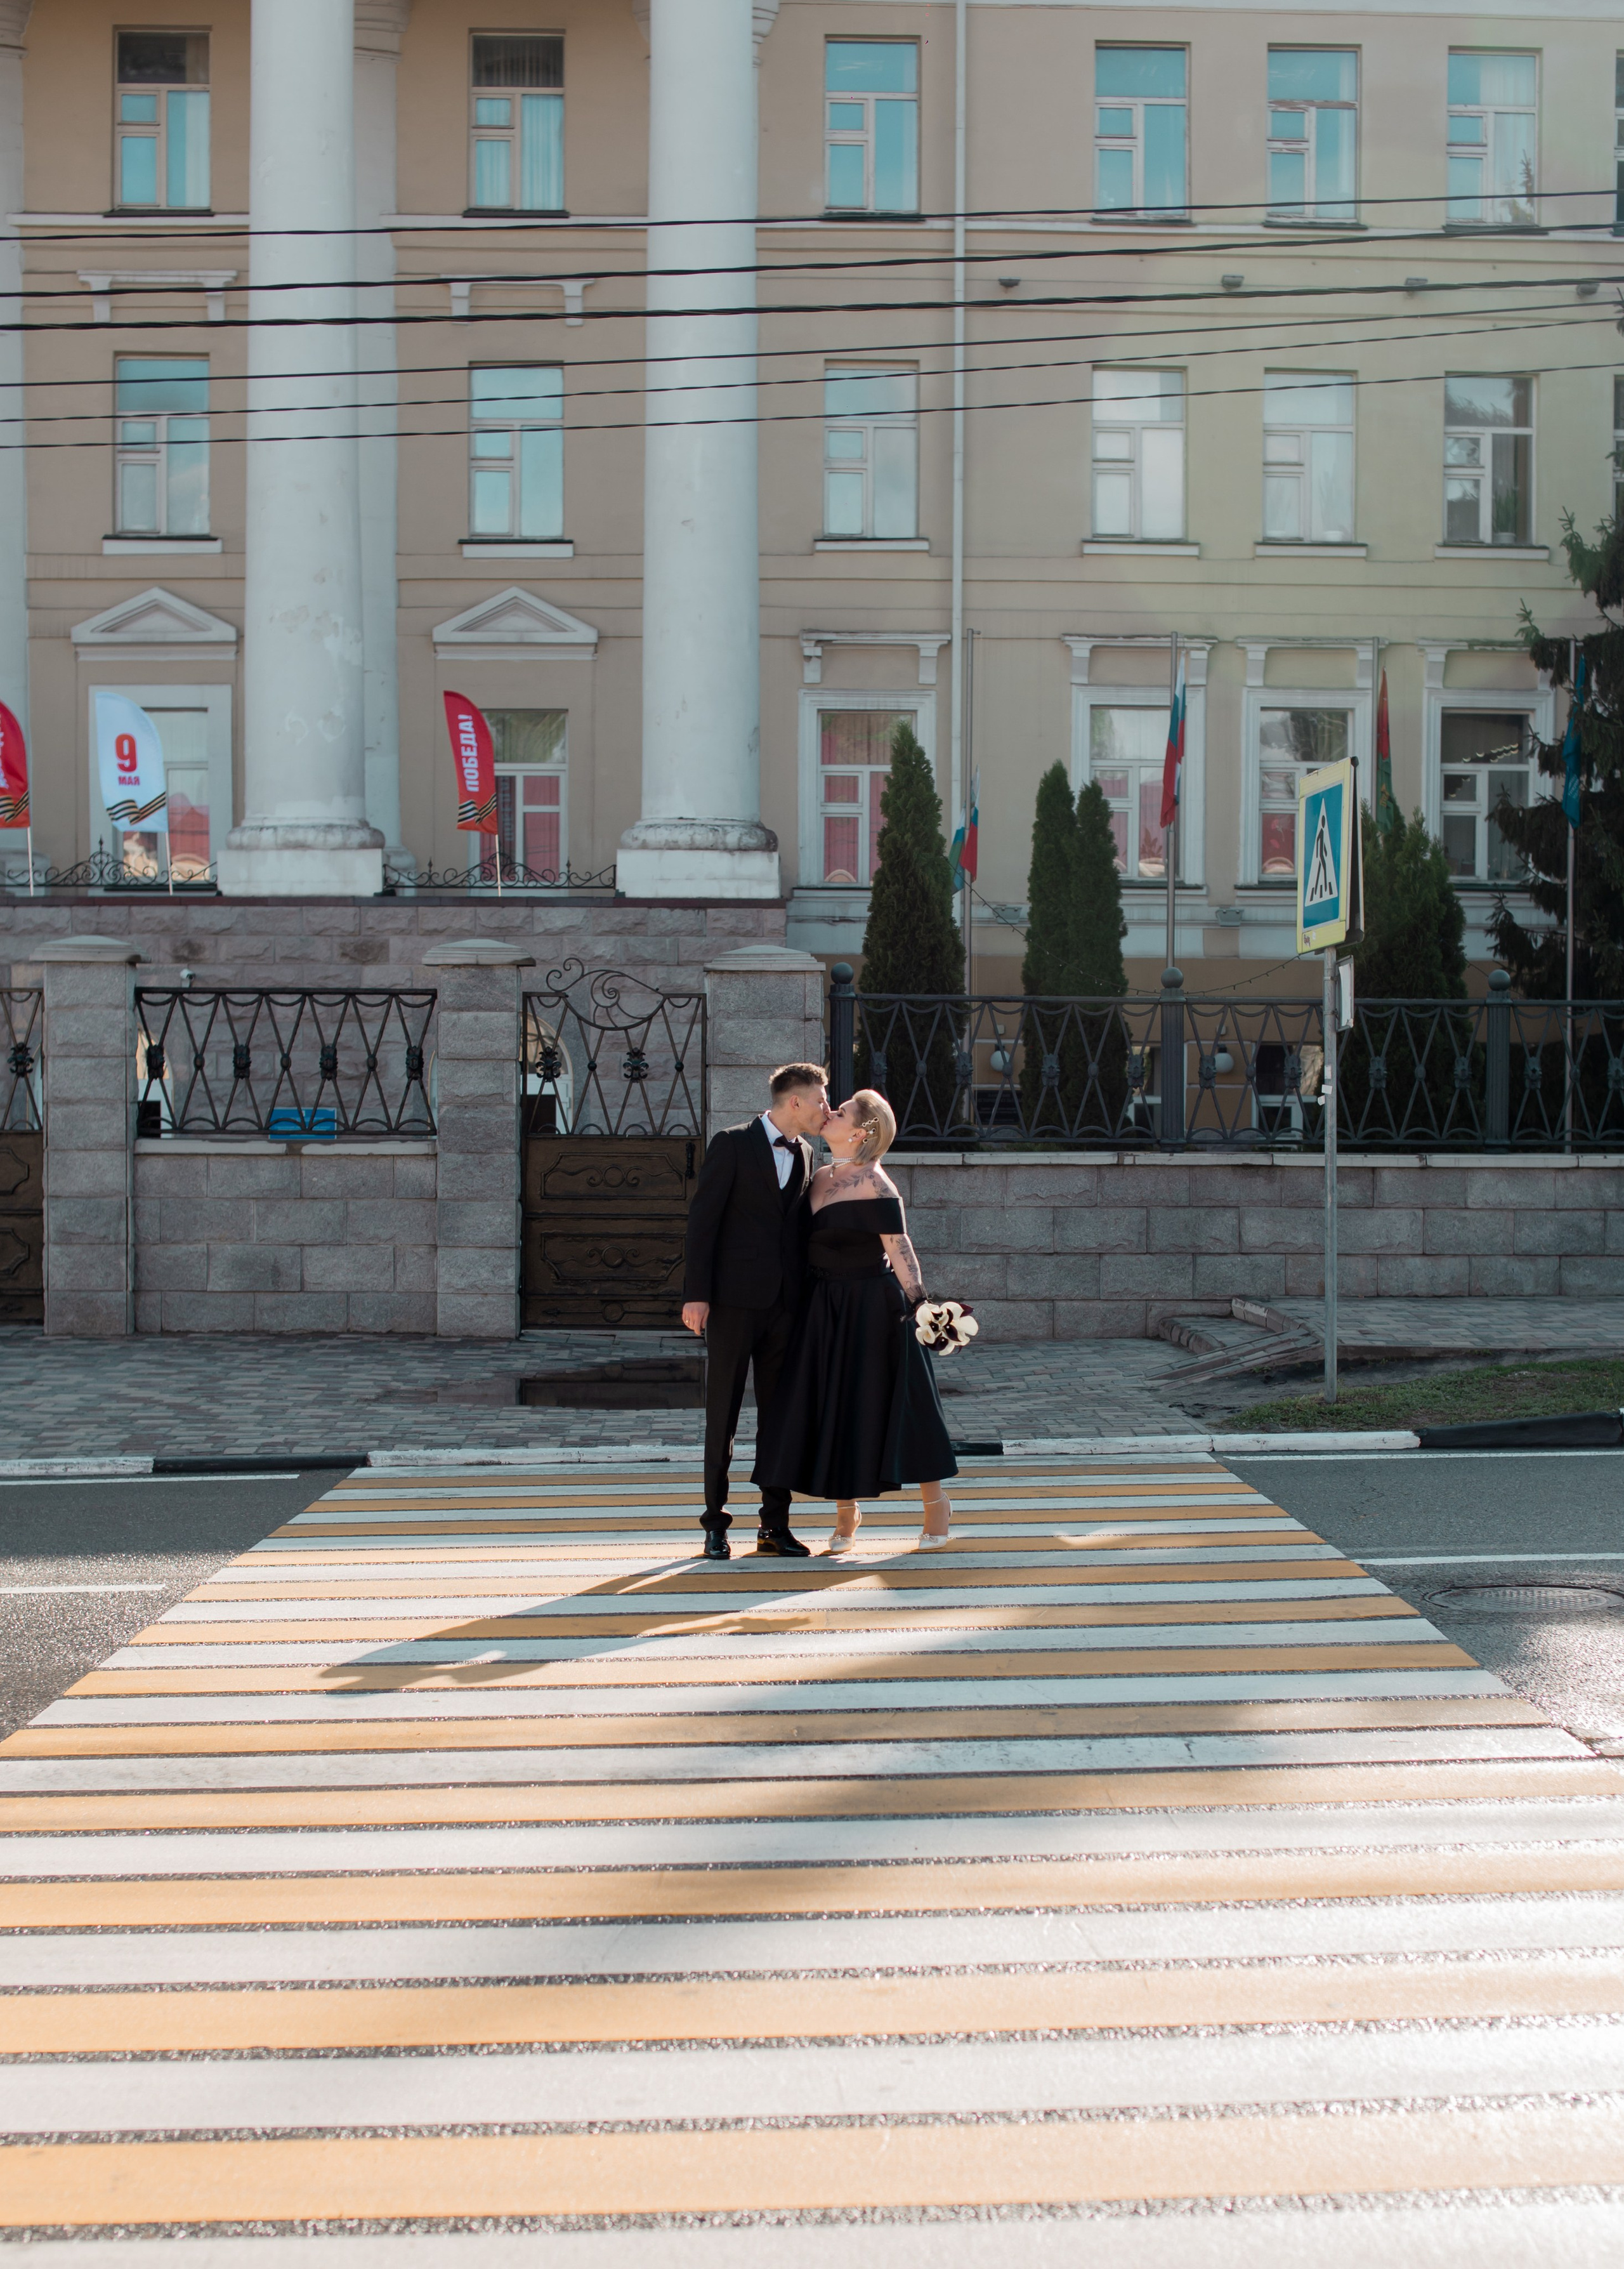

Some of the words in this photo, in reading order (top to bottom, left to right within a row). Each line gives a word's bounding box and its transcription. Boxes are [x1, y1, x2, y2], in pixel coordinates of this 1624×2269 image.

[115, 733, 137, 773] 9
[458, 714, 479, 792] ПОБЕДА!
[118, 775, 140, 786] МАЯ
